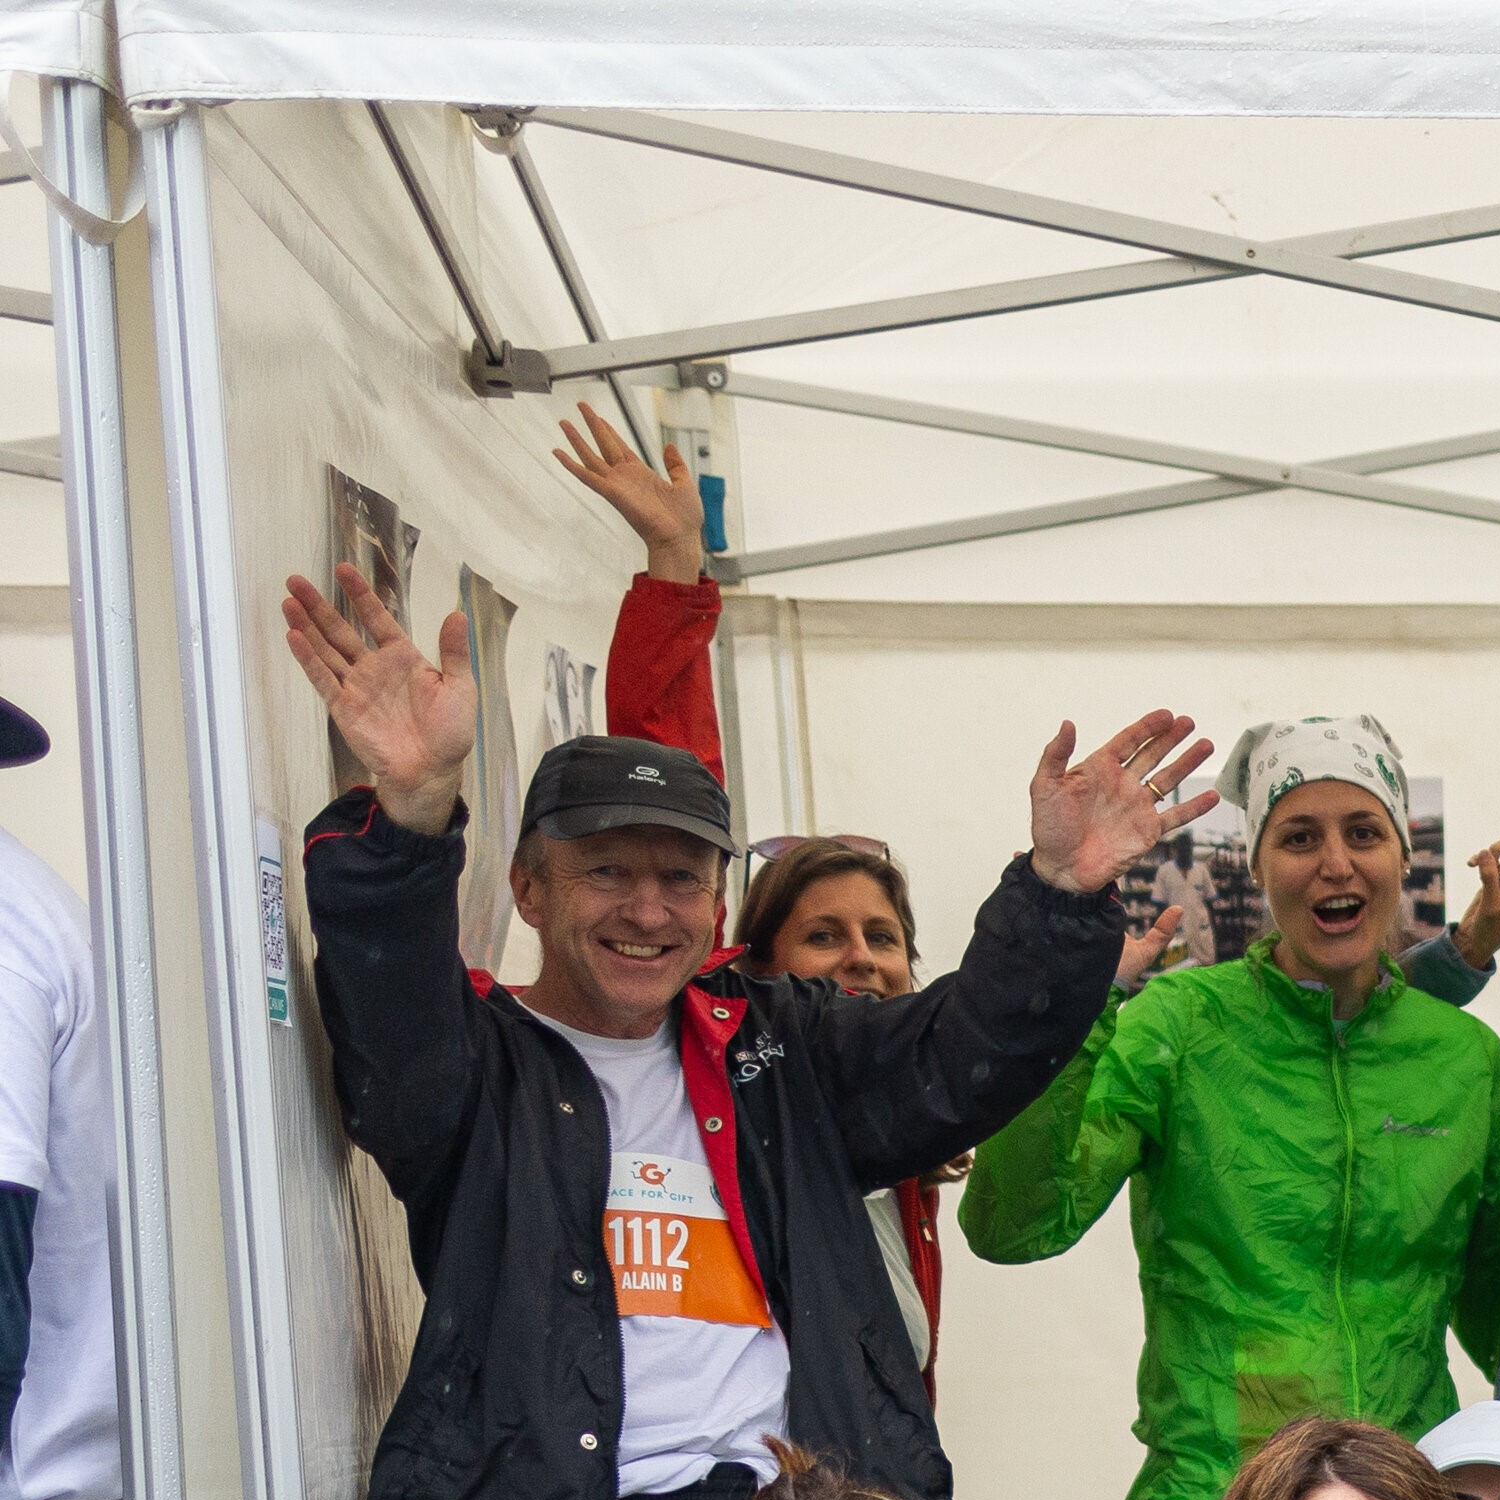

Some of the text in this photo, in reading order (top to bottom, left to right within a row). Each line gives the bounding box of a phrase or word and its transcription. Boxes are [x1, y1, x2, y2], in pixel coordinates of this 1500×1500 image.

[641, 1190, 694, 1204] FOR GIFT
[608, 1216, 690, 1270] 1112
[621, 1271, 667, 1291] ALAIN
